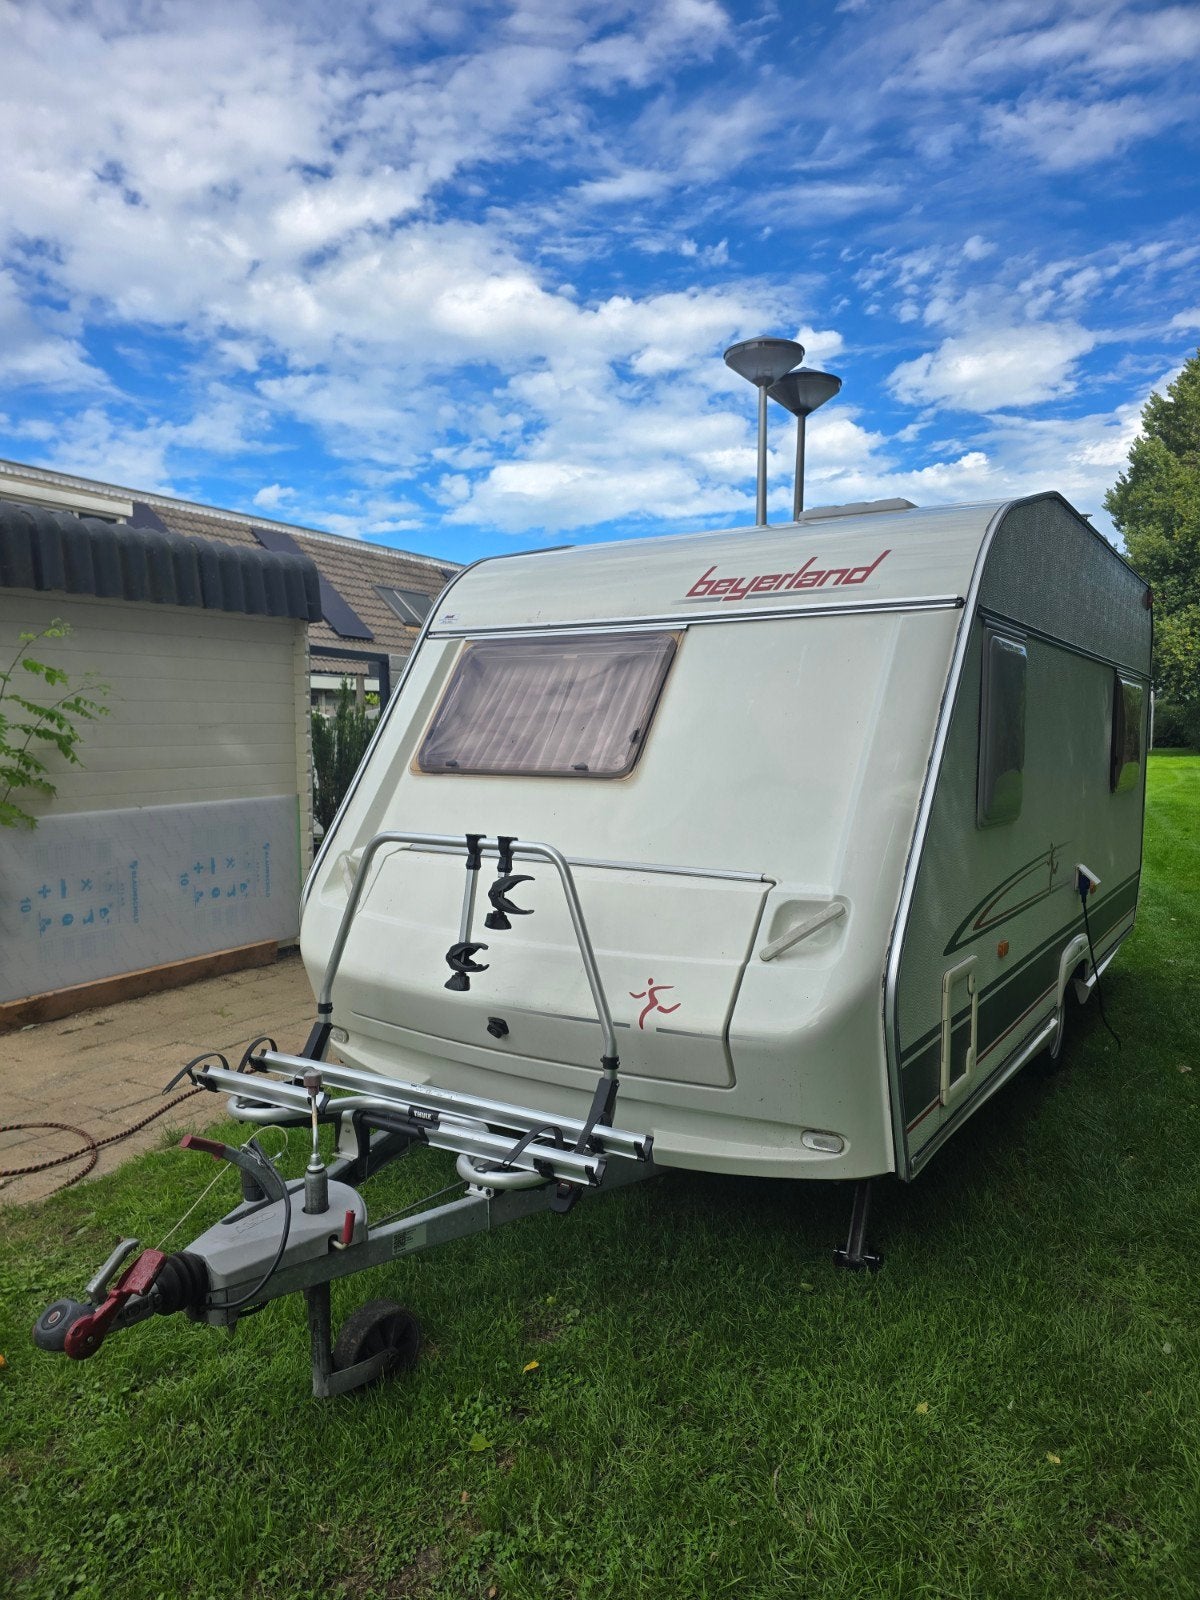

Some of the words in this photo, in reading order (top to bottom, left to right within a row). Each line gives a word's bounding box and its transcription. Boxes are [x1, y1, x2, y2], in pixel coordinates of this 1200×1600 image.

[685, 549, 892, 602] beyerland
[20, 896, 31, 913] 10
[413, 1110, 433, 1120] THULE
